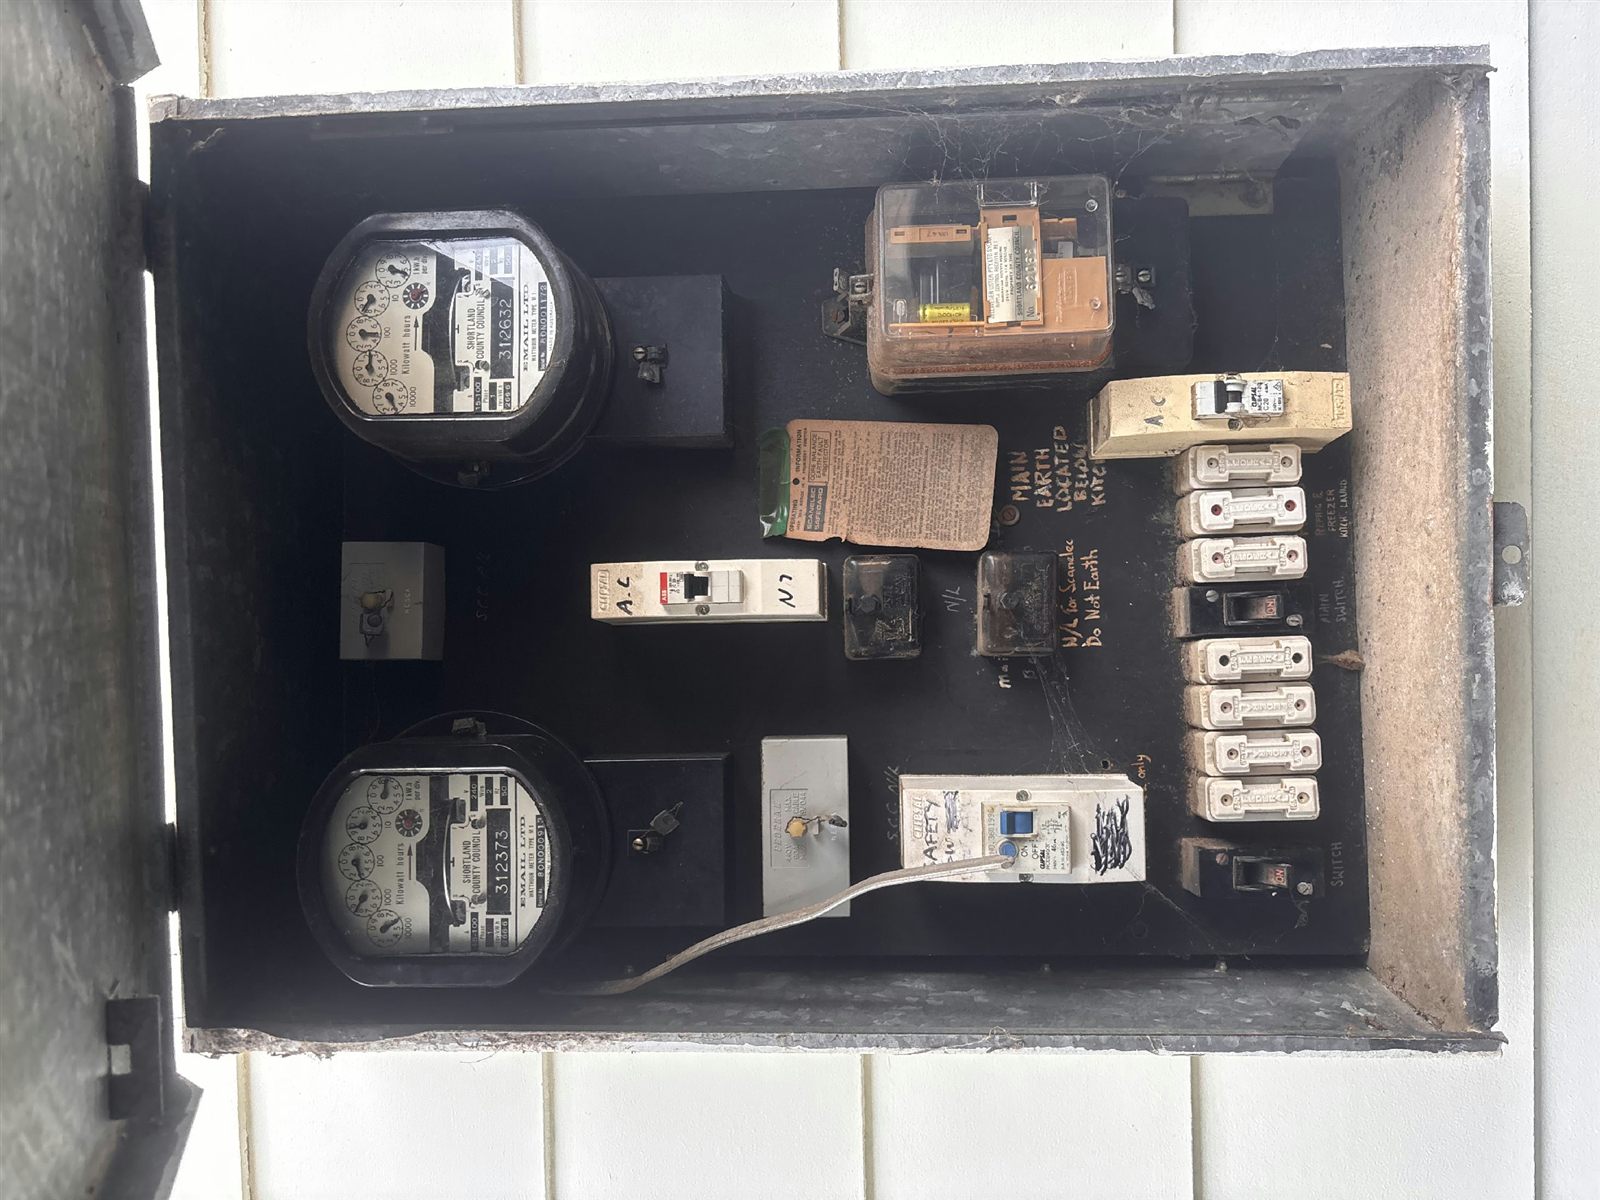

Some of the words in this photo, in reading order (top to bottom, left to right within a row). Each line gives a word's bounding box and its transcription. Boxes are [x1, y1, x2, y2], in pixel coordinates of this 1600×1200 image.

[1013, 230, 1021, 255] COUNCIL
[476, 300, 485, 329] COUNCIL
[1015, 282, 1024, 316] SHORTLAND
[402, 315, 410, 337] hours
[466, 308, 476, 349] SHORTLAND
[498, 298, 512, 360] 312632
[402, 342, 410, 374] Kilowatt
[476, 332, 485, 359] COUNTY
[1008, 451, 1032, 501] MAIN
[1034, 448, 1054, 507] EARTH
[1053, 426, 1072, 512] LOCATED
[1072, 442, 1088, 502] BELOW
[788, 500, 798, 532] OPERATING
[806, 488, 816, 530] SCANELEC
[1326, 489, 1338, 532] FREEZER
[1059, 540, 1076, 593] Scanelec
[1080, 549, 1100, 590] Earth
[1084, 594, 1100, 620] Not
[1266, 600, 1276, 614] ON
[1081, 628, 1102, 648] Do
[1131, 754, 1151, 778] only
[502, 786, 508, 796] 50
[396, 843, 404, 866] hours
[462, 840, 470, 884] SHORTLAND
[472, 830, 480, 862] COUNCIL
[495, 830, 508, 894] 312373
[1020, 845, 1028, 858] ON
[1274, 868, 1284, 882] ON
[1330, 841, 1344, 886] SWITCH
[396, 872, 404, 904] Kilowatt
[472, 866, 480, 894] COUNTY
